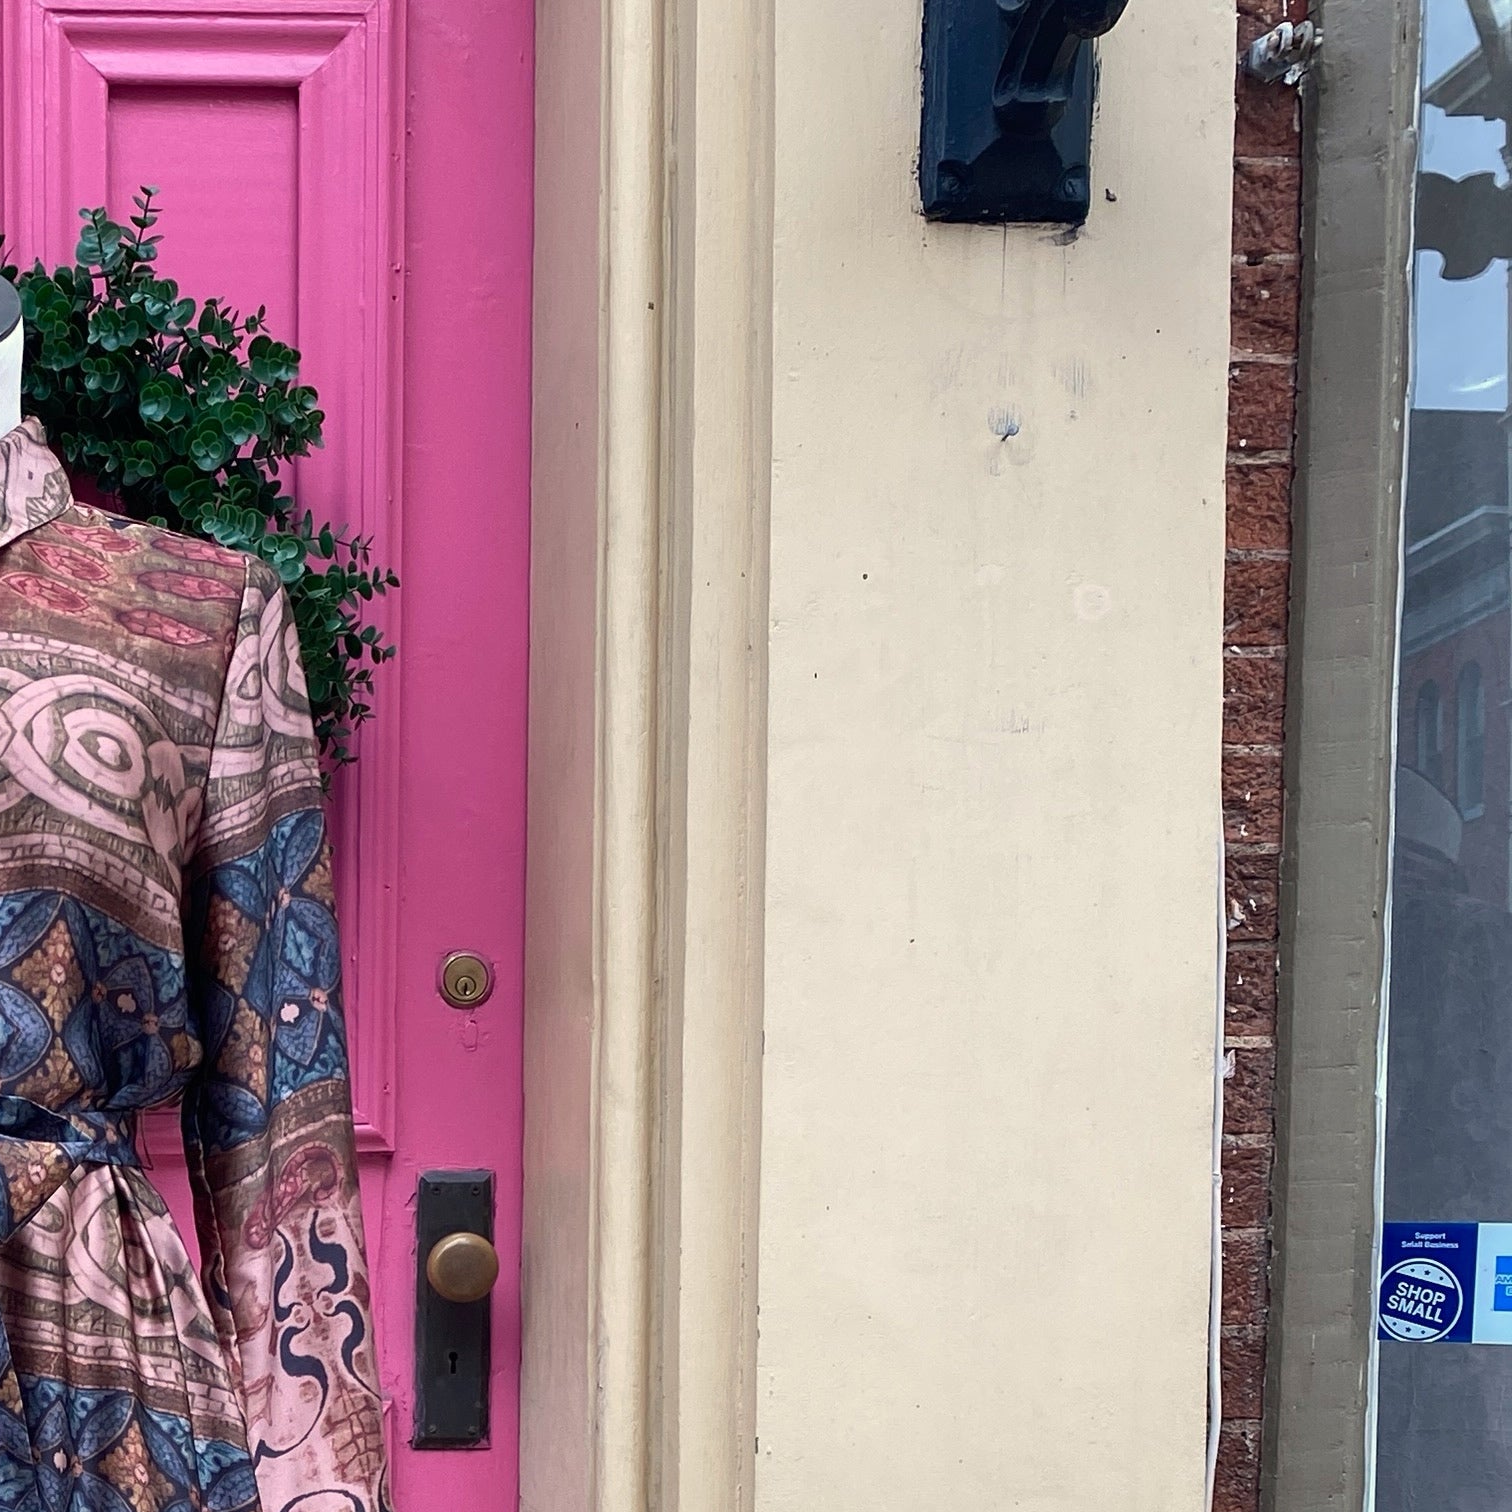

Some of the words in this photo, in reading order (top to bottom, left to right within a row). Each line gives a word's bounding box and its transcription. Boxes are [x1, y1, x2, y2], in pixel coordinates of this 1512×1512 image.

[1414, 1232, 1445, 1240] Support
[1396, 1282, 1446, 1305] SHOP
[1387, 1295, 1443, 1323] SMALL
